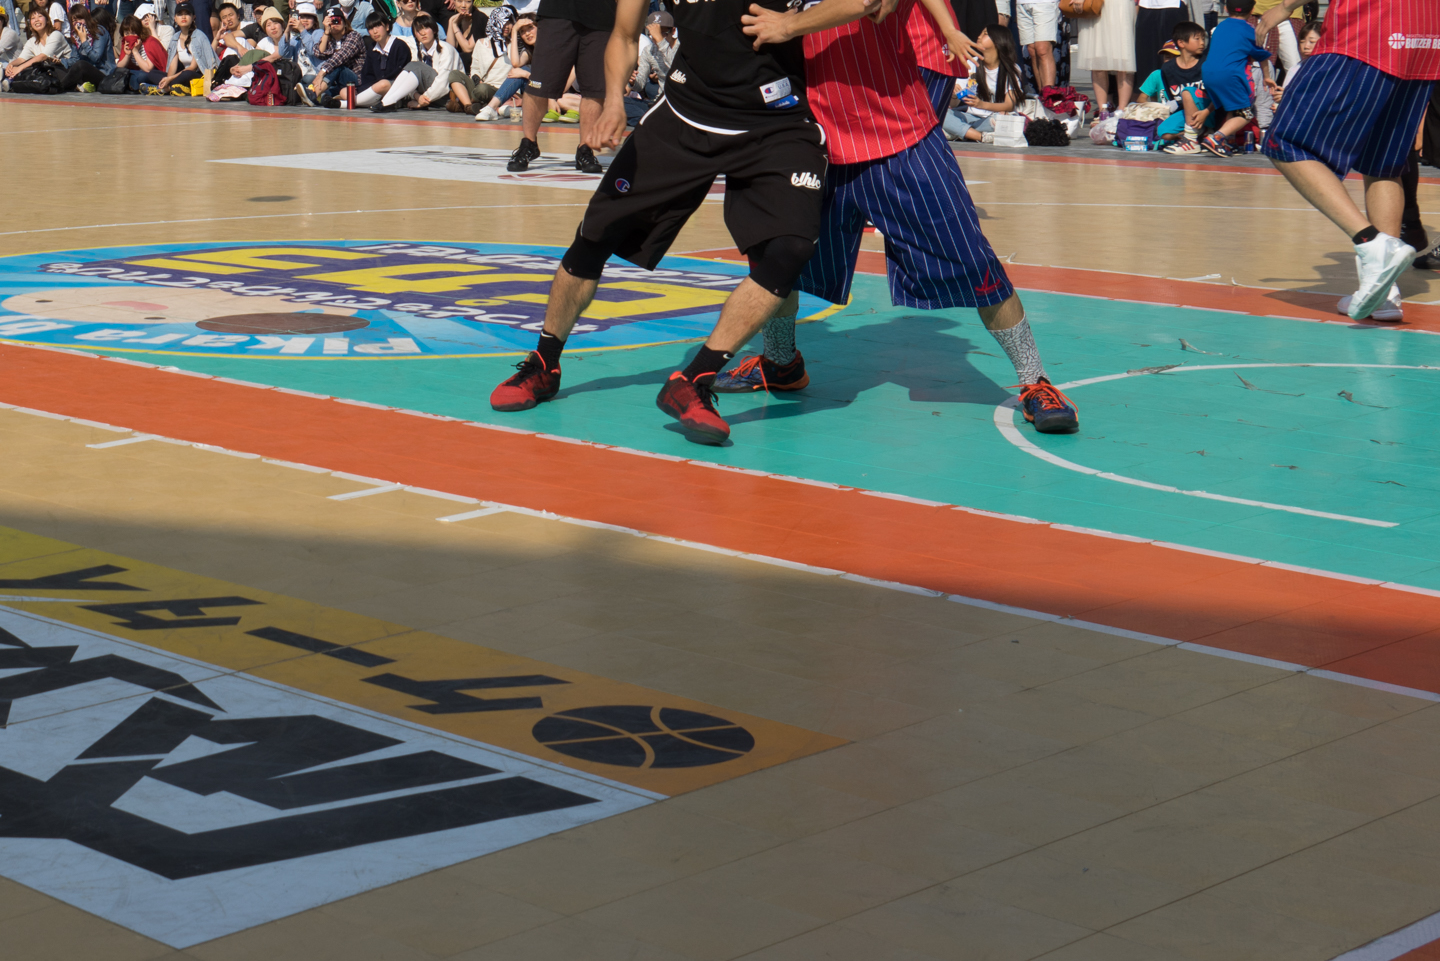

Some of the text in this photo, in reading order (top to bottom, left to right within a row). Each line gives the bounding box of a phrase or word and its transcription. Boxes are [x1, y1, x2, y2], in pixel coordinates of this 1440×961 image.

[1405, 38, 1432, 49] BUZZER
[122, 246, 733, 320] ピカラ
[74, 328, 422, 354] Pikara
